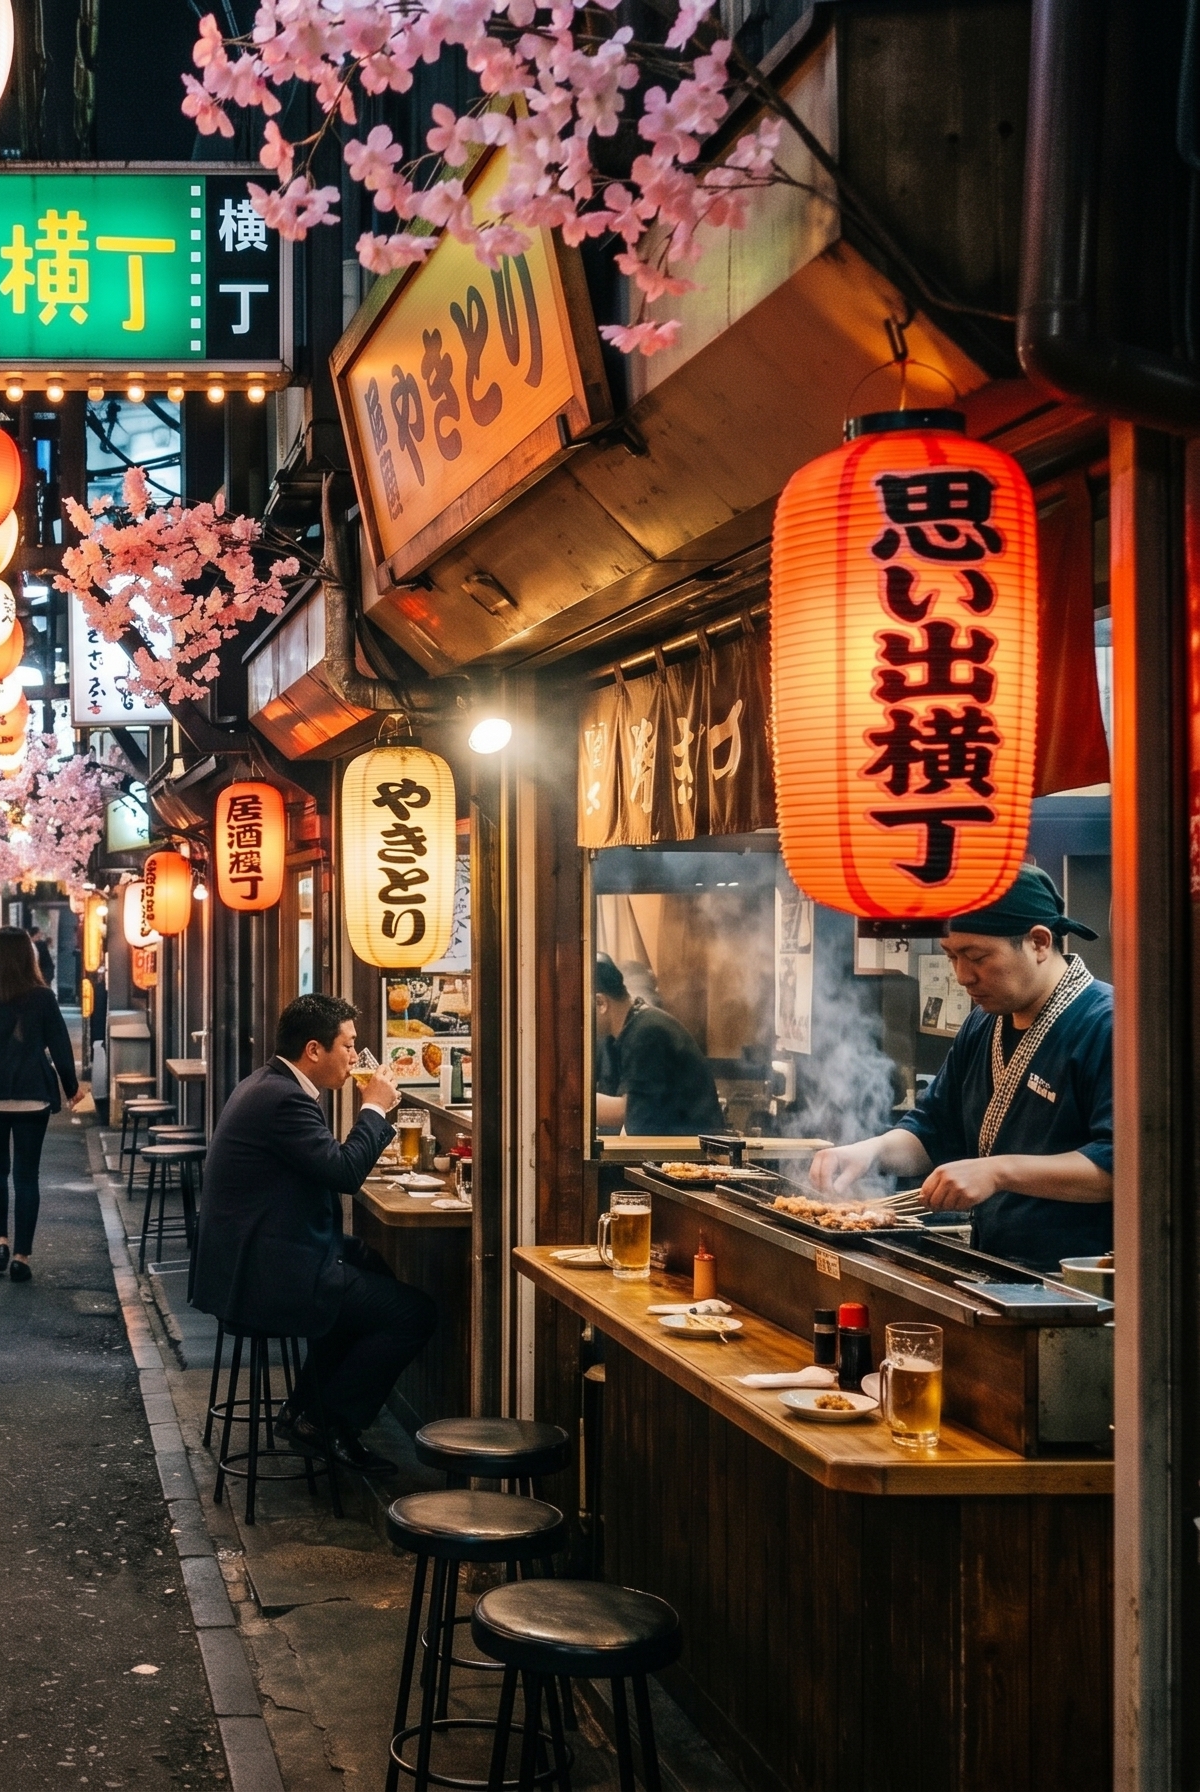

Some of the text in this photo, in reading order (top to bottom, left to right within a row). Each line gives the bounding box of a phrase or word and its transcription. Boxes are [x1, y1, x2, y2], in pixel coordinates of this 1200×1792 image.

[218, 198, 270, 335] 横丁
[389, 250, 545, 487] やきとり
[865, 470, 1003, 884] 思い出横丁
[371, 778, 432, 946] やきとり
